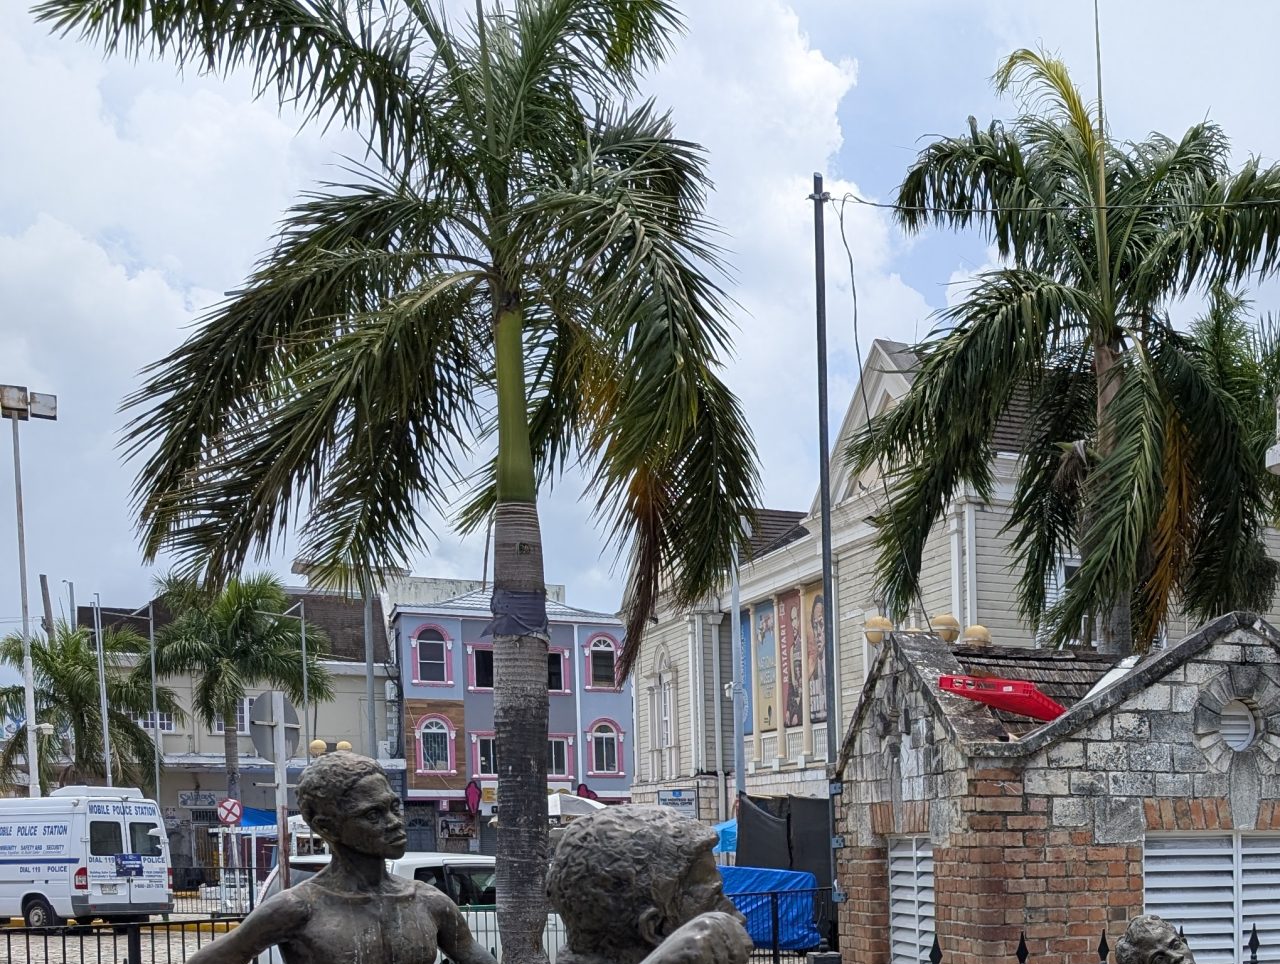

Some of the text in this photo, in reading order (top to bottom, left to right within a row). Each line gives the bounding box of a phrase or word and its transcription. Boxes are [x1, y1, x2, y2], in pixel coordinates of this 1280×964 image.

[88, 804, 110, 815] MOBILE
[112, 805, 133, 815] POLICE
[134, 805, 157, 816] STATION
[17, 825, 38, 836] POLICE
[42, 825, 68, 836] STATION
[143, 856, 165, 864] POLICE
